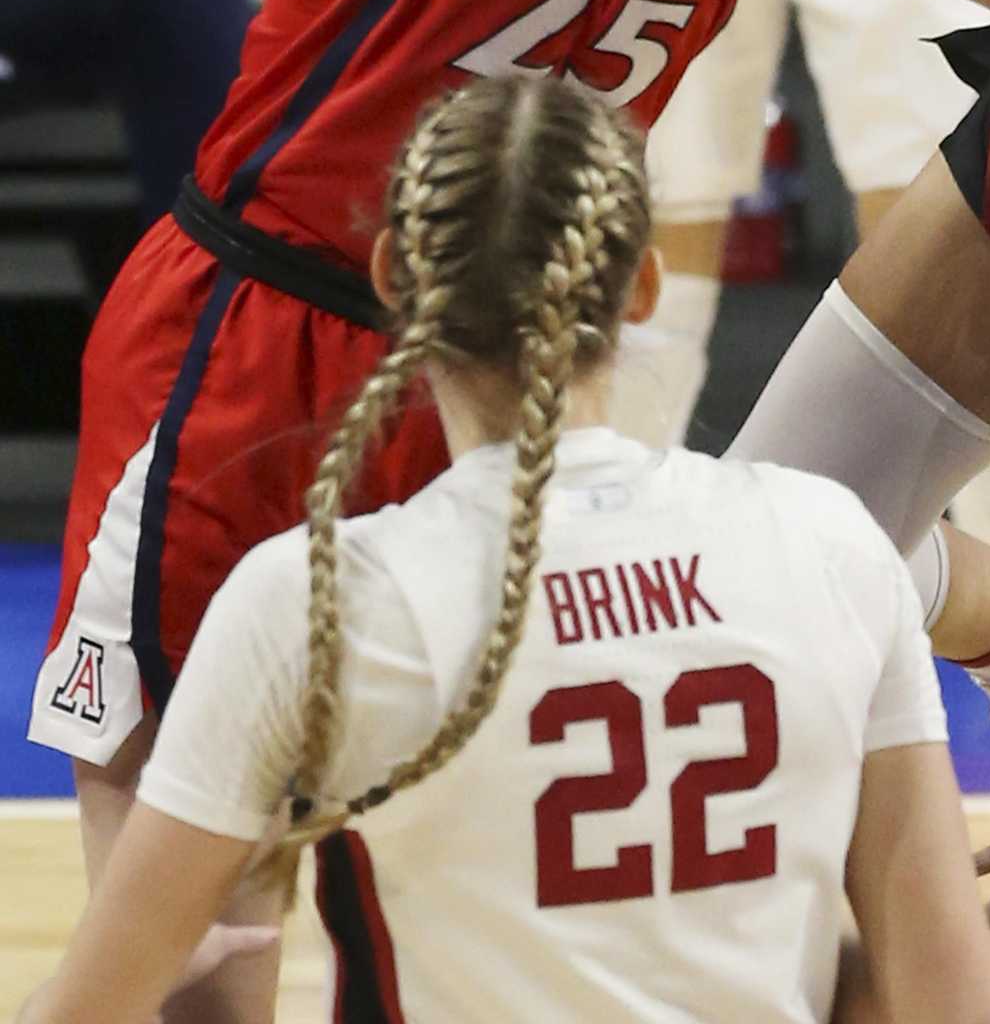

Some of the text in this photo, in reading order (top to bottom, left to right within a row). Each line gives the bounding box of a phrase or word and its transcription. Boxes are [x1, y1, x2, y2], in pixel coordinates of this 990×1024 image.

[542, 553, 723, 646] BRINK
[50, 635, 107, 725] A
[528, 662, 780, 909] 22
